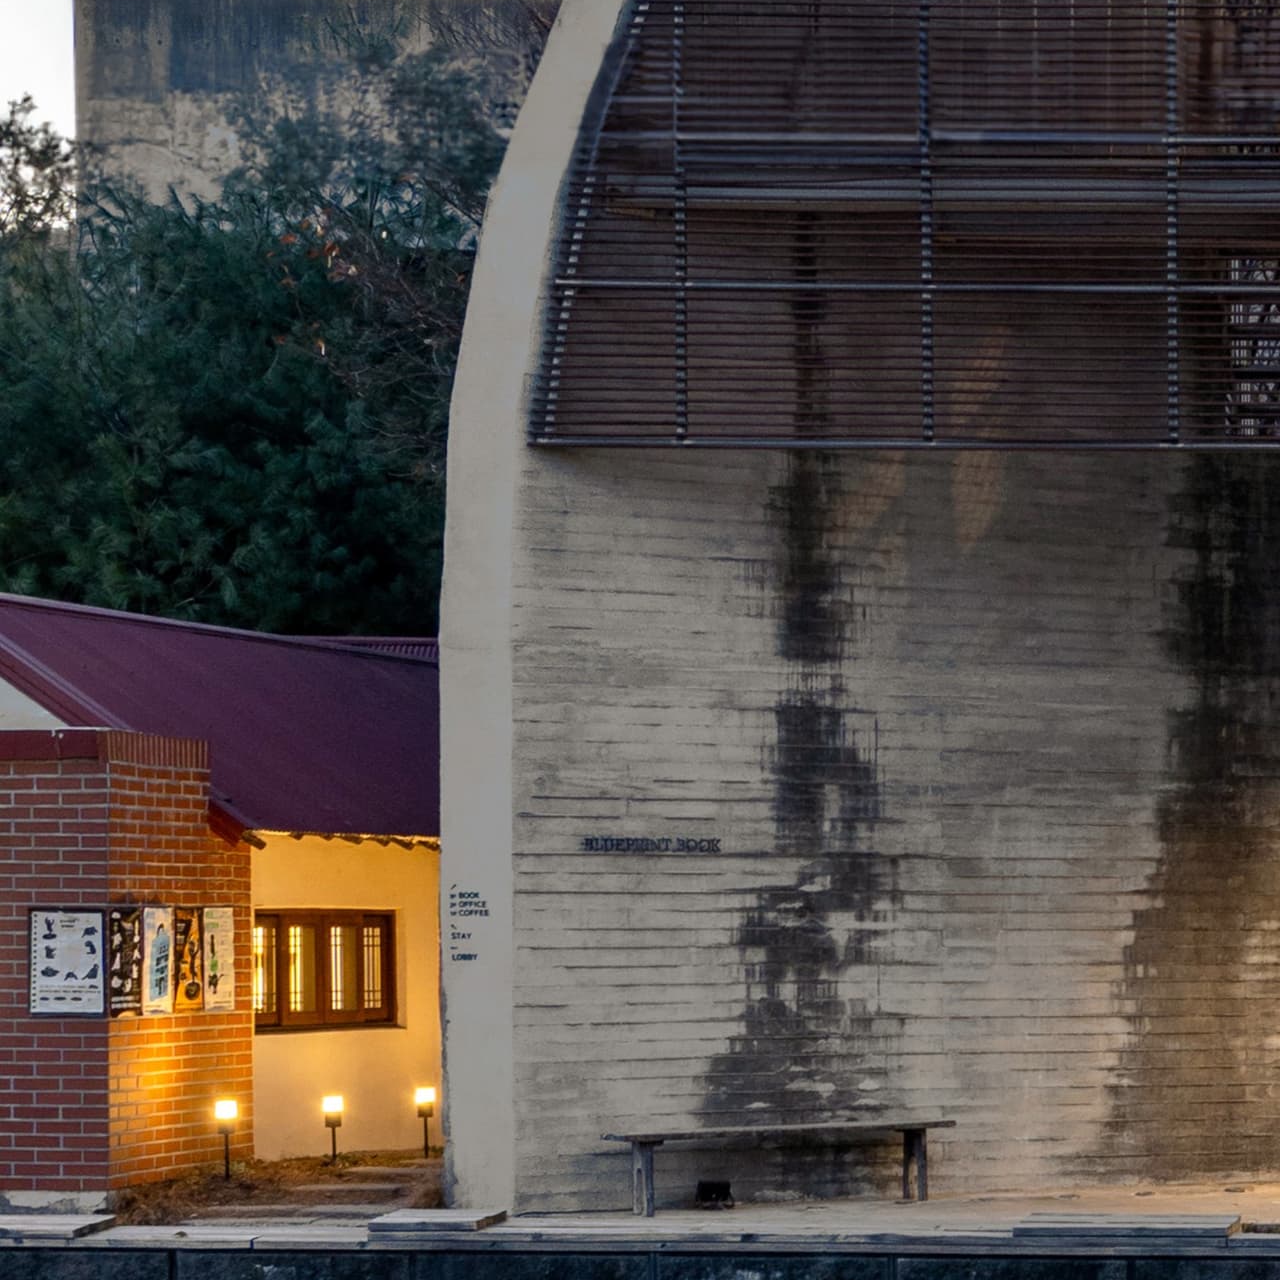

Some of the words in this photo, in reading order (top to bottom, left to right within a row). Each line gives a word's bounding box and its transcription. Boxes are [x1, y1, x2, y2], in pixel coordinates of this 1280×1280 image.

[676, 836, 722, 852] BOOK
[458, 900, 487, 908] OFFICE
[458, 909, 490, 917] COFFEE
[450, 932, 472, 940] STAY
[451, 953, 479, 961] LOBBY
